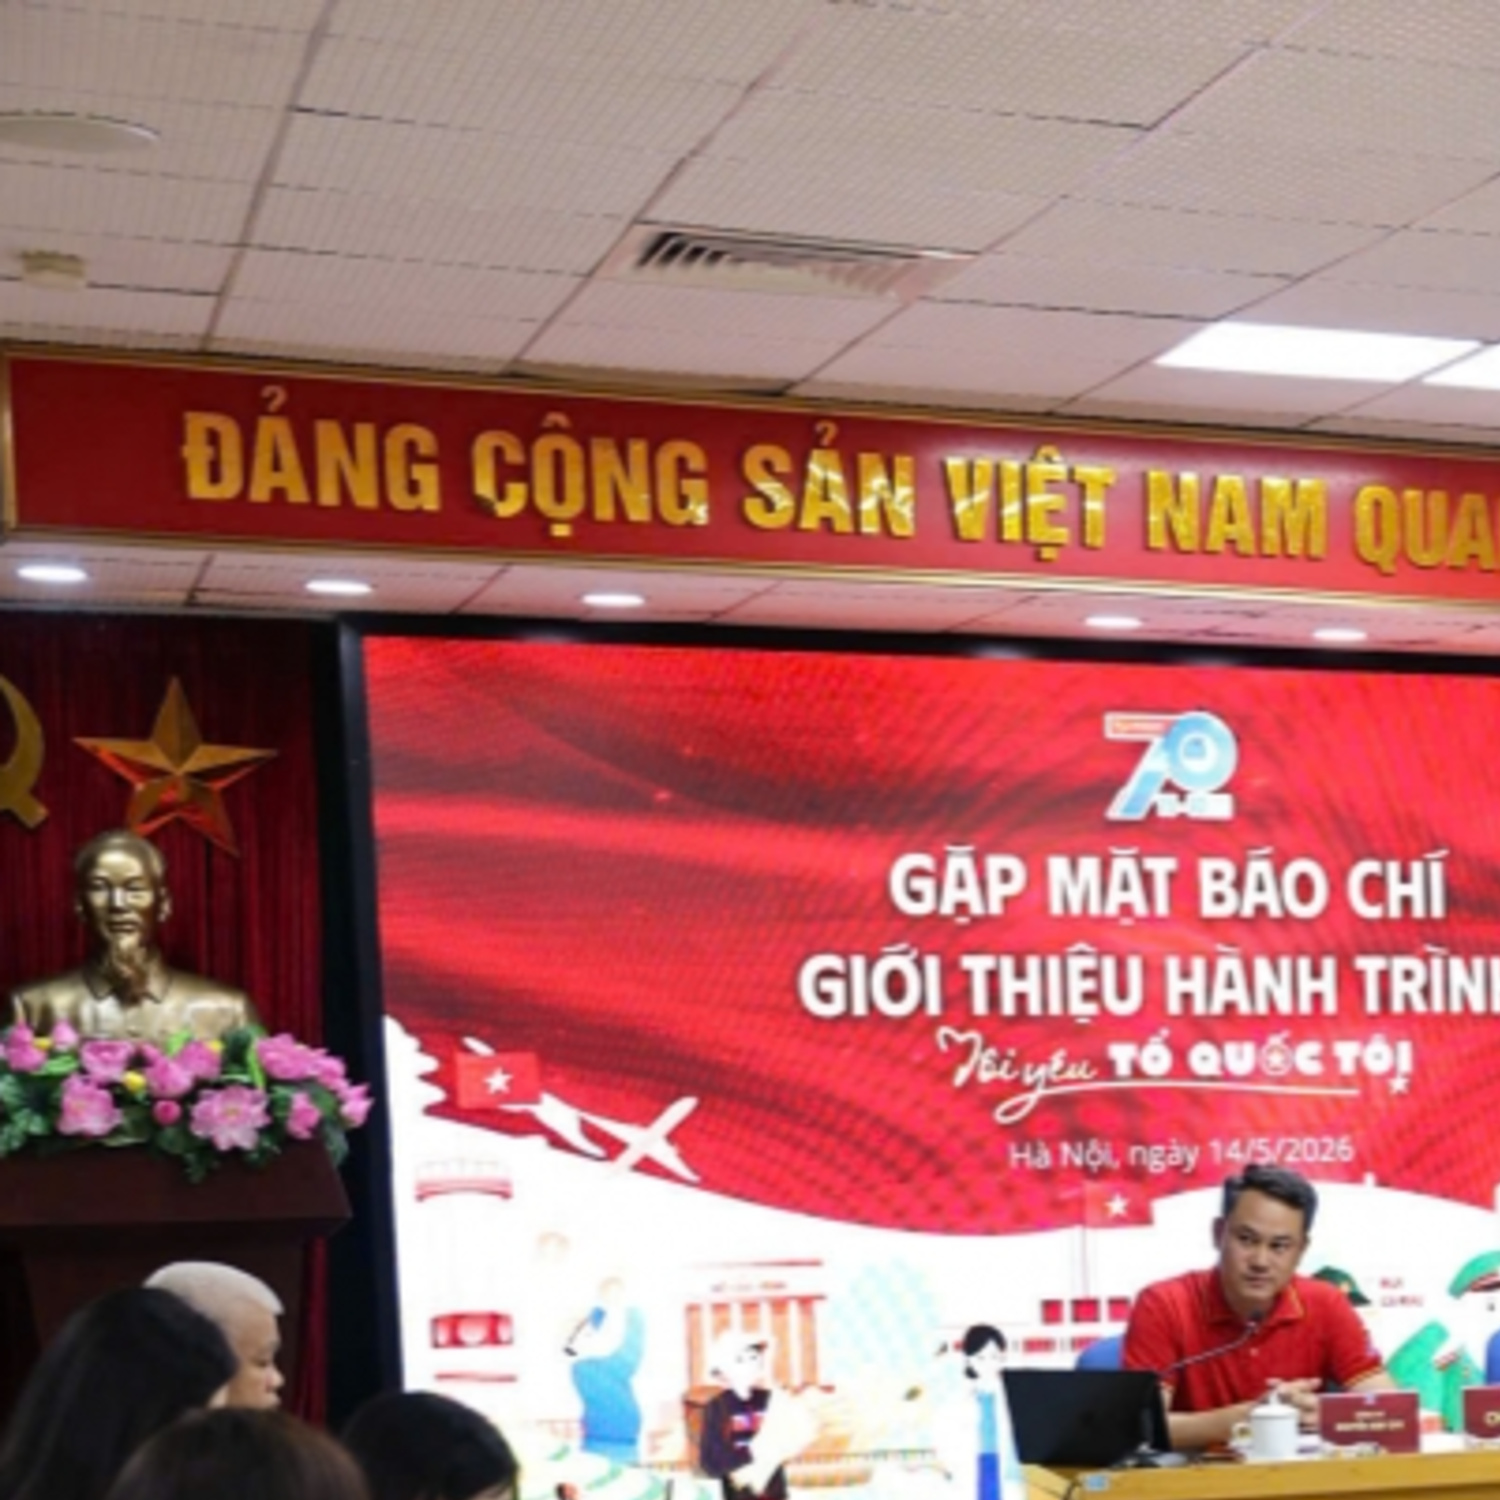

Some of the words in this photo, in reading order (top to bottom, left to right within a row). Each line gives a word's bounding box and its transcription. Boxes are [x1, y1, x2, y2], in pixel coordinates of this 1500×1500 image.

[182, 384, 442, 512] ĐẢNG
[470, 412, 709, 538] CỘNG
[740, 421, 917, 537] SẢN
[943, 445, 1117, 562] VIỆT
[1143, 468, 1328, 560] NAM
[889, 845, 1028, 926] GẶP
[1047, 845, 1178, 926] MẶT
[1198, 847, 1329, 920] BÁO
[1346, 849, 1449, 920] CHÍ
[798, 942, 941, 1018] GIỚI
[960, 942, 1143, 1024] THIỆU
[1165, 943, 1338, 1018] HÀNH
[1008, 1140, 1052, 1170] Hà
[1060, 1138, 1121, 1173] Nội,
[1129, 1138, 1200, 1174] ngày
[1208, 1133, 1355, 1166] 14/5/2026
